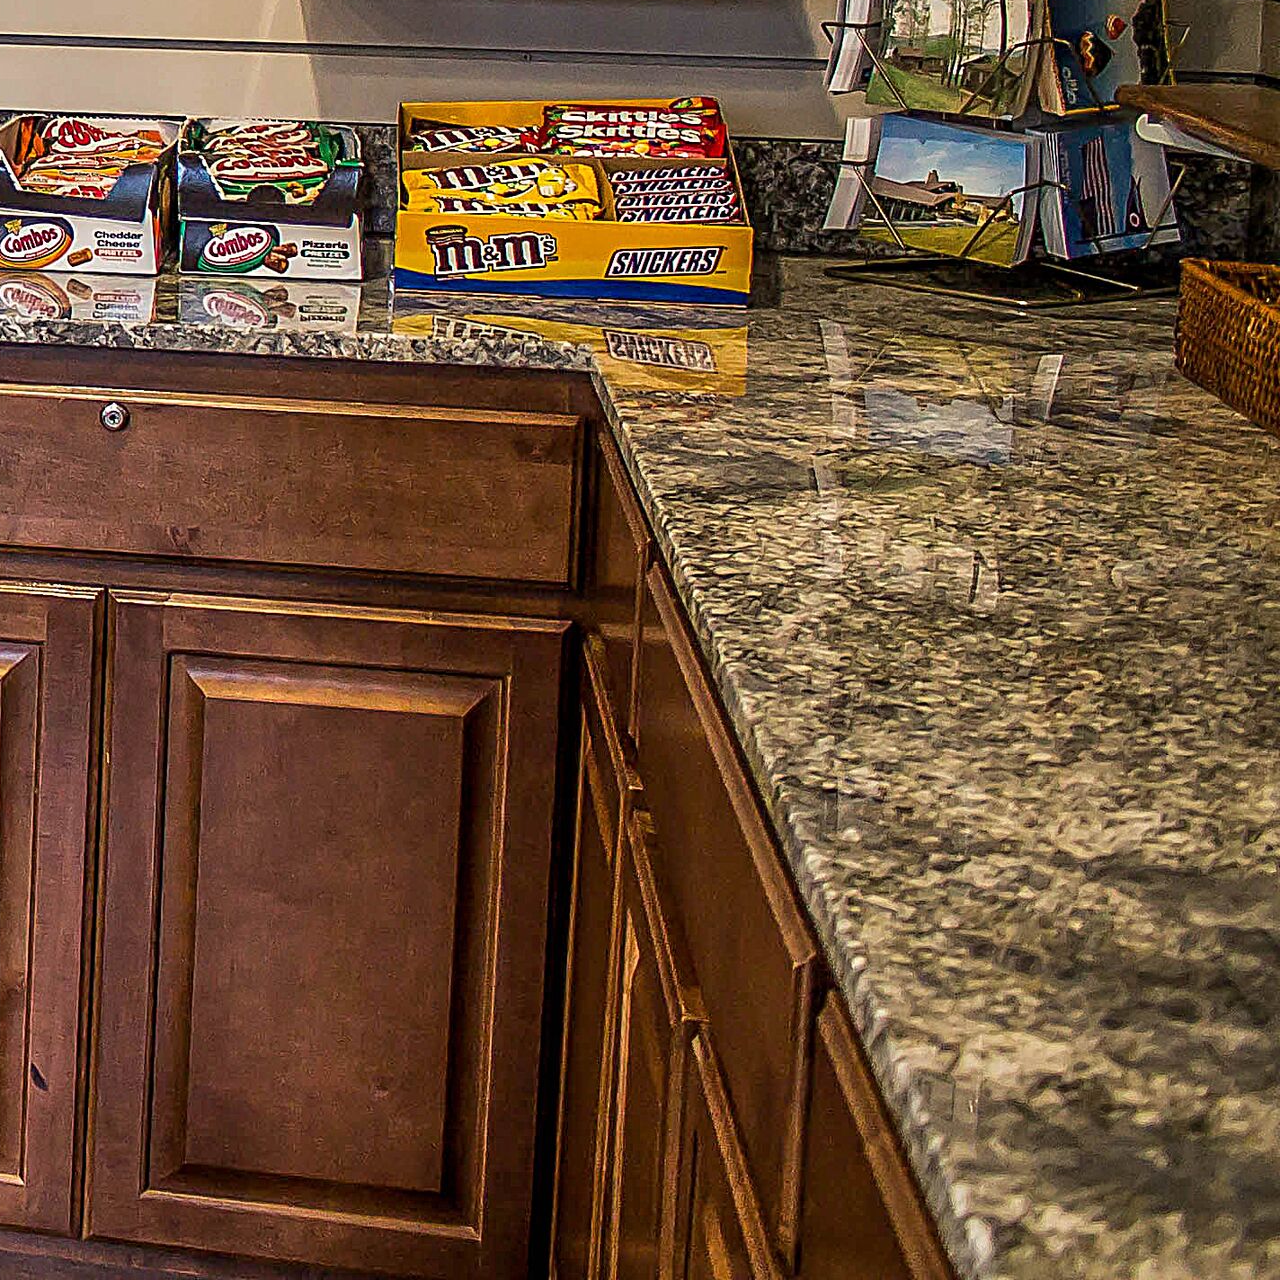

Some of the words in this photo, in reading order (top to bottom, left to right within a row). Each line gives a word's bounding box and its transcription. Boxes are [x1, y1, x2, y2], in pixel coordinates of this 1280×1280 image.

[561, 110, 702, 125] Skittles
[556, 122, 701, 142] Skittles
[4, 228, 58, 253] Combos
[94, 231, 143, 240] Cheddar
[97, 240, 140, 248] Cheese
[209, 233, 264, 258] Combos
[302, 240, 349, 250] Pizzeria
[611, 249, 717, 275] SNICKERS
